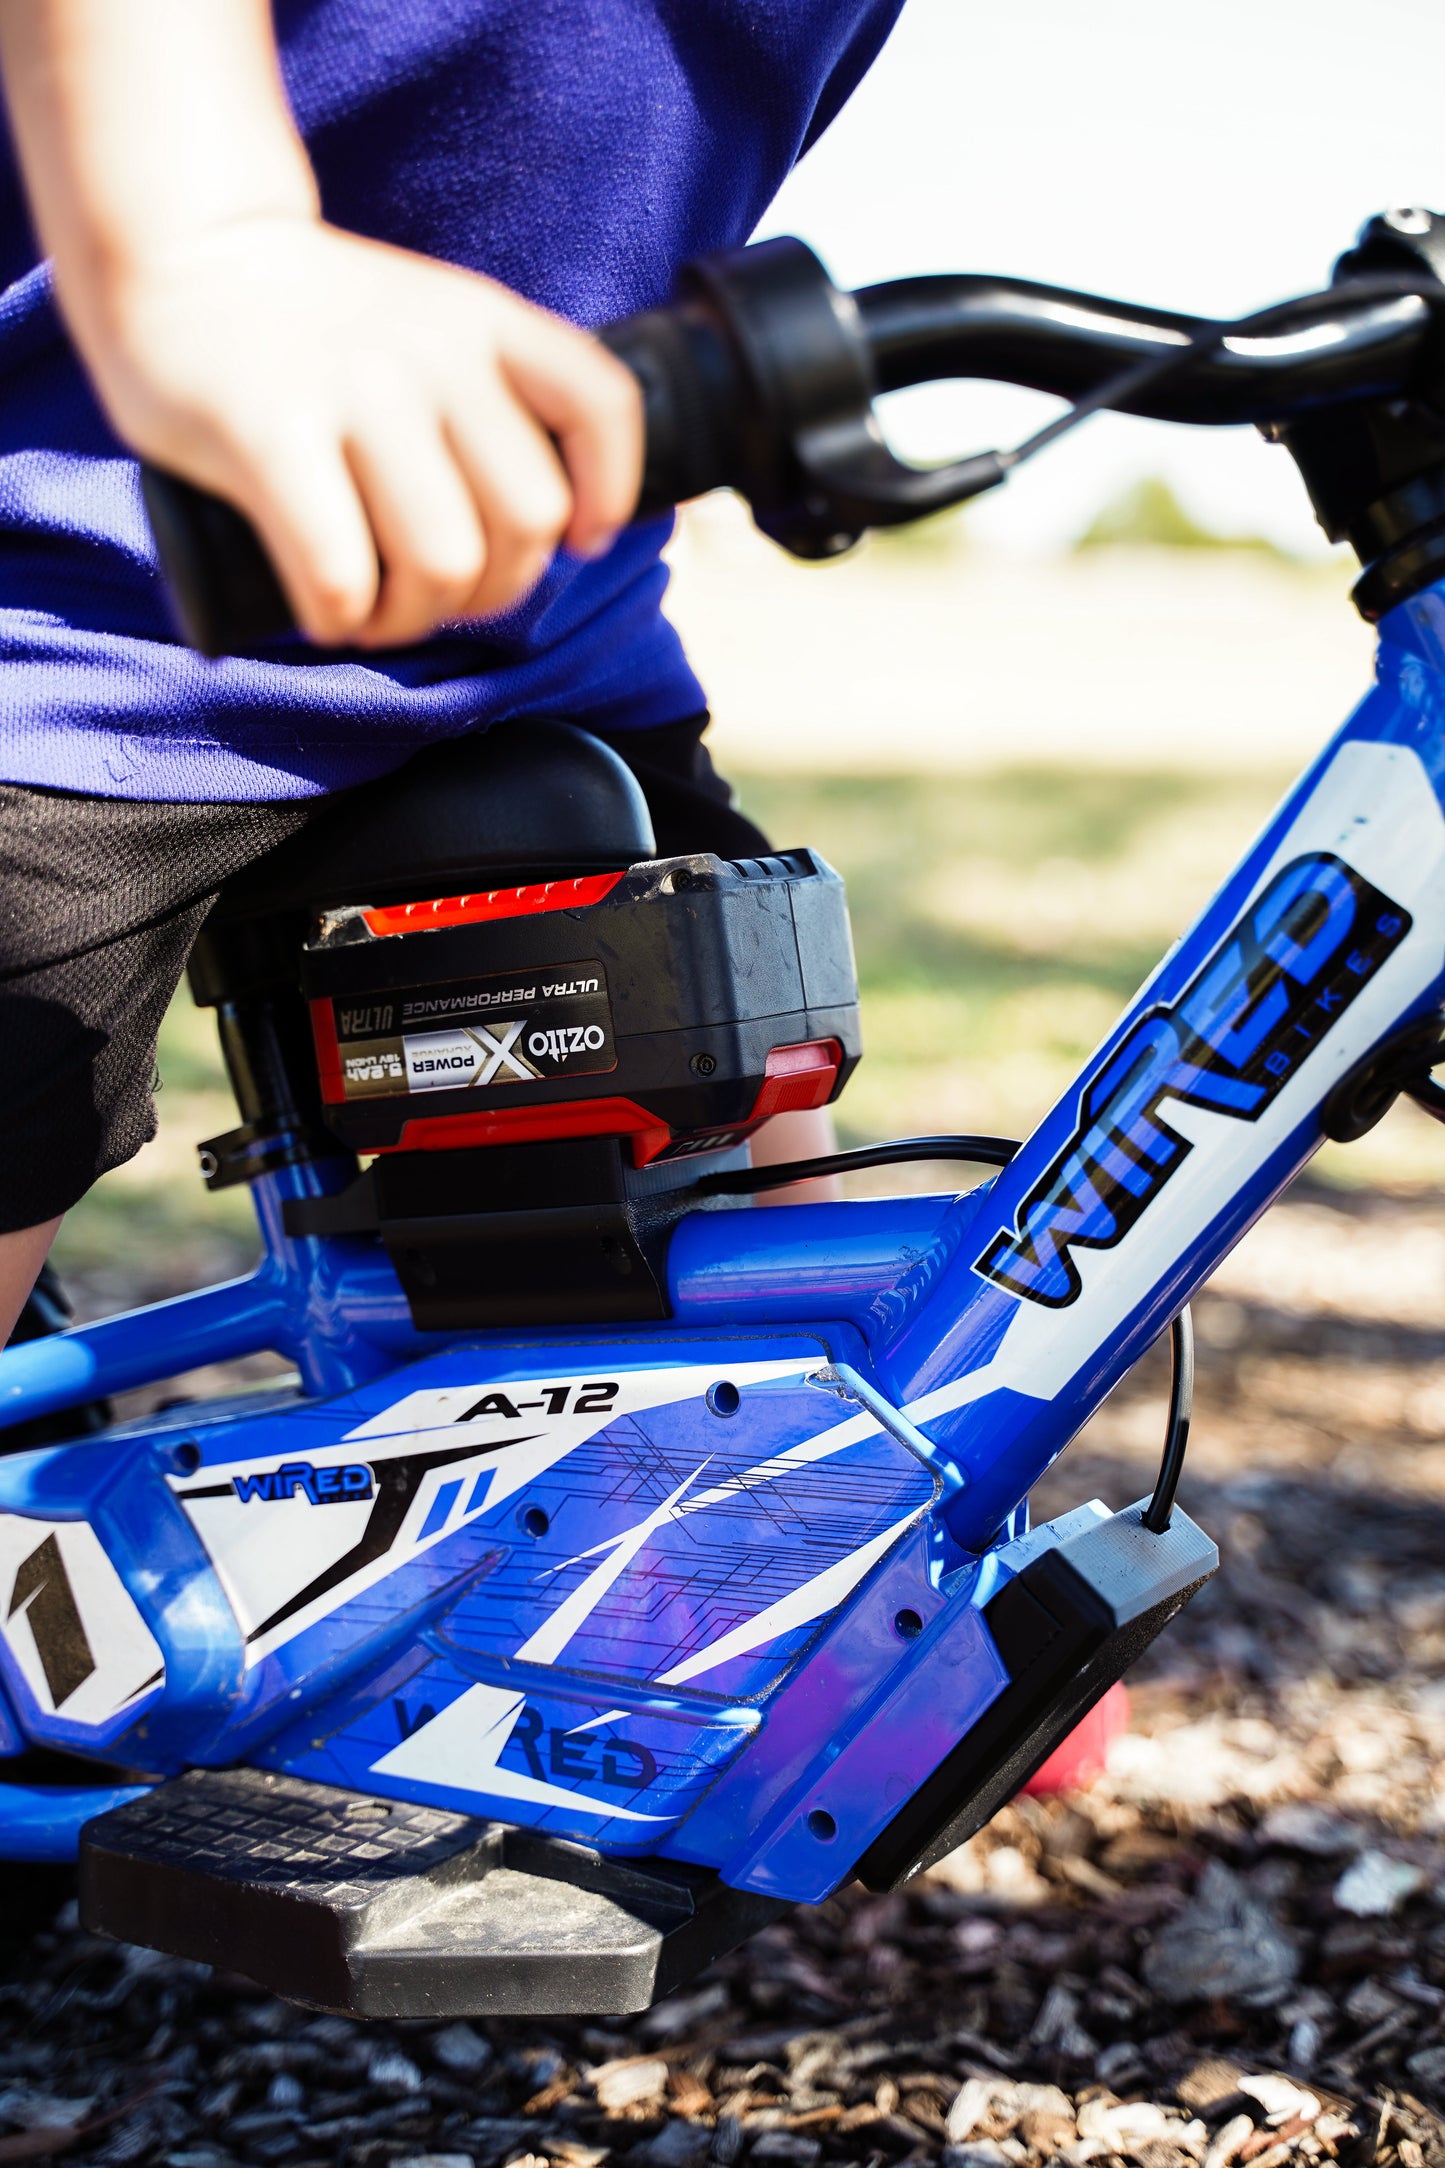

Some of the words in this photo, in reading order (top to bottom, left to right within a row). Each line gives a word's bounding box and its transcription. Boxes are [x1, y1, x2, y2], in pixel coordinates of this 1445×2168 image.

[402, 986, 536, 1016] PERFORMANCE
[541, 978, 599, 997] ULTRA
[1264, 914, 1401, 1076] BIKES
[340, 1005, 394, 1035] ULTRA
[346, 1062, 403, 1081] 5.2Ah
[412, 1055, 475, 1073] POWER
[988, 861, 1357, 1300] WIRED
[454, 1382, 619, 1422] A-12
[233, 1461, 371, 1504] WIRED
